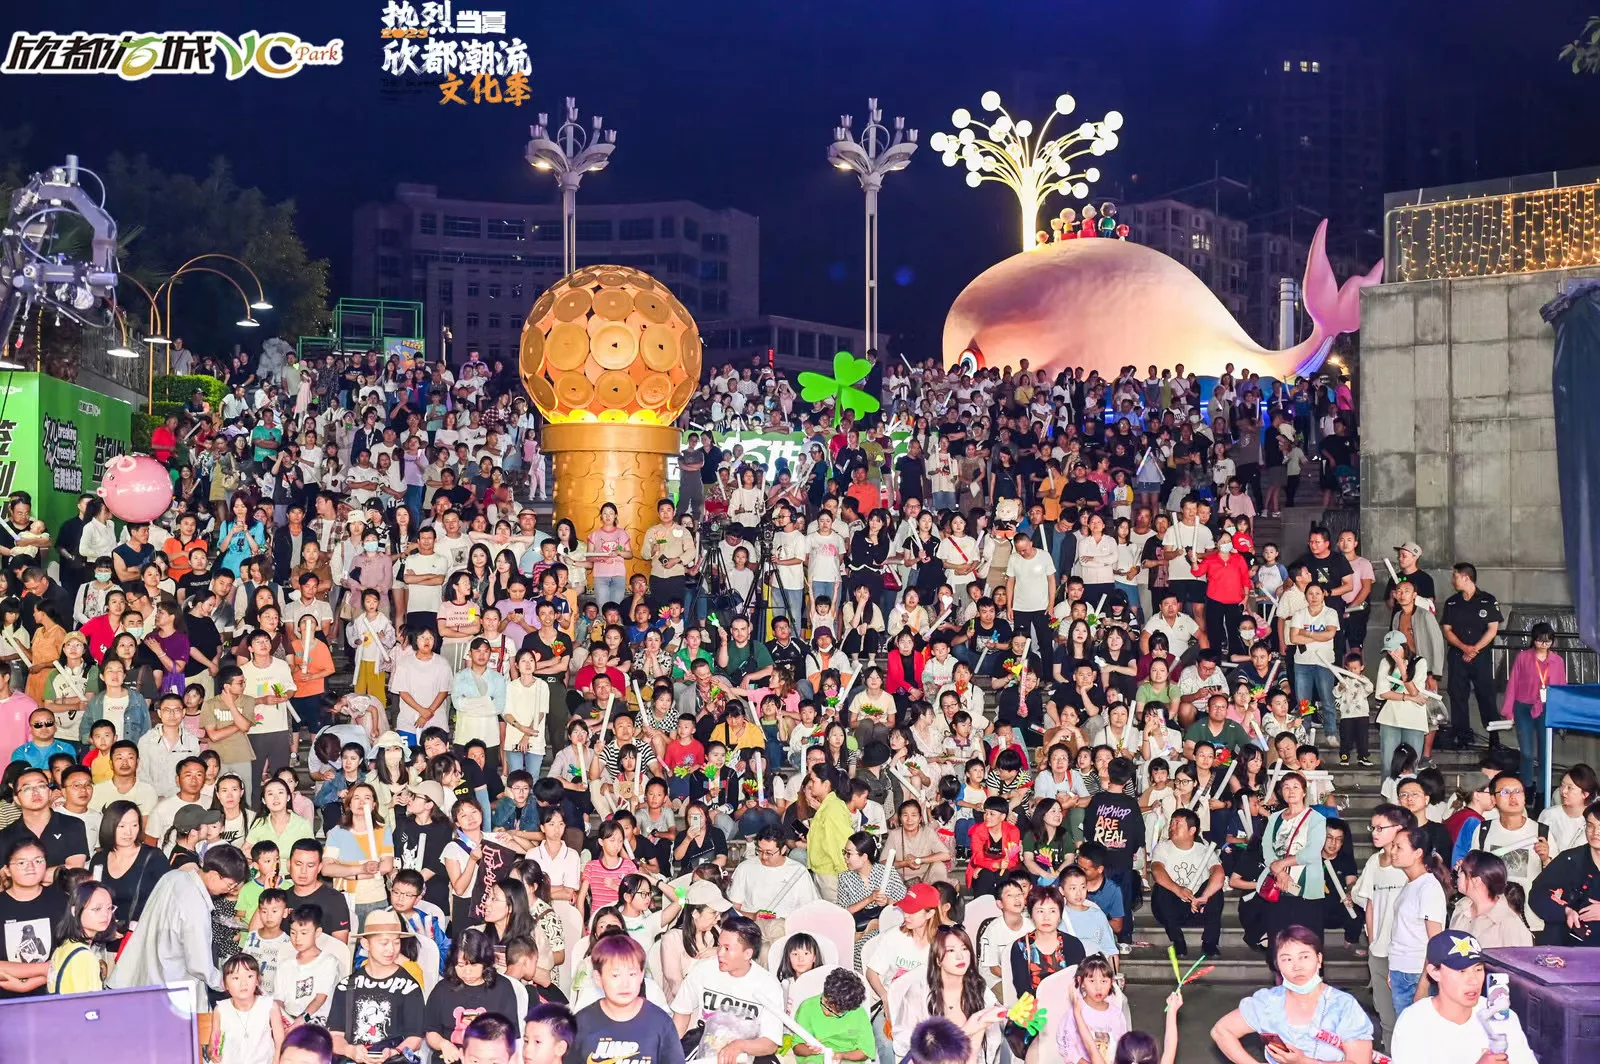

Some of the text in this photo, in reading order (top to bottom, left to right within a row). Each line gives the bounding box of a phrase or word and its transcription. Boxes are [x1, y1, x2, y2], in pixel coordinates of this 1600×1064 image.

[1304, 624, 1325, 632] FILA
[1095, 815, 1119, 831] ARE
[1093, 826, 1127, 848] REAL
[703, 991, 759, 1020] CLOUD
[590, 1040, 640, 1060] JUMP
